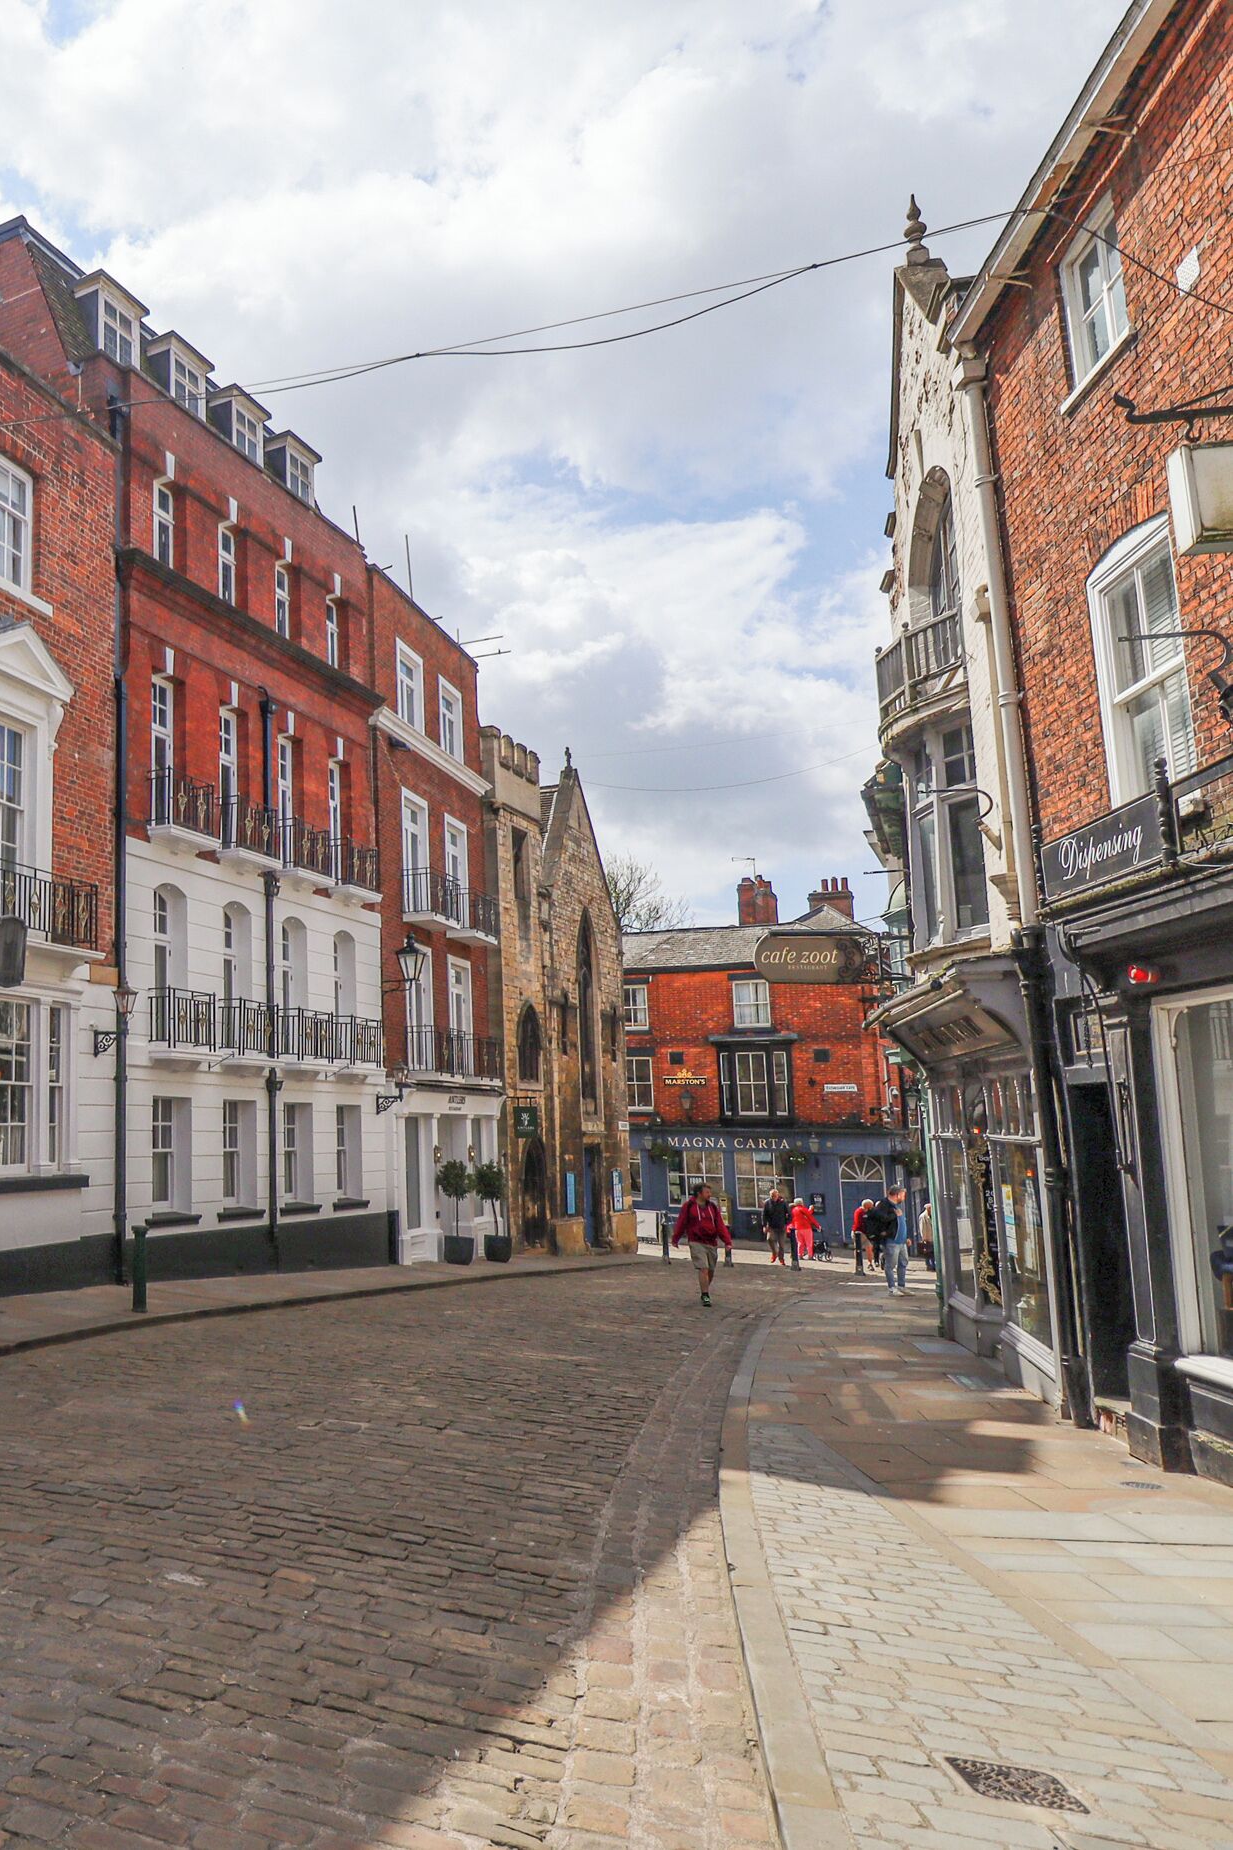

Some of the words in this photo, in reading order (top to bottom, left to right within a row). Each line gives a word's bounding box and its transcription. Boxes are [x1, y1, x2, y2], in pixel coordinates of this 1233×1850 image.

[1059, 823, 1143, 881] Dispensing
[761, 947, 796, 964] cafe
[800, 949, 838, 964] zoot
[668, 1137, 726, 1148] MAGNA
[734, 1138, 790, 1149] CARTA
